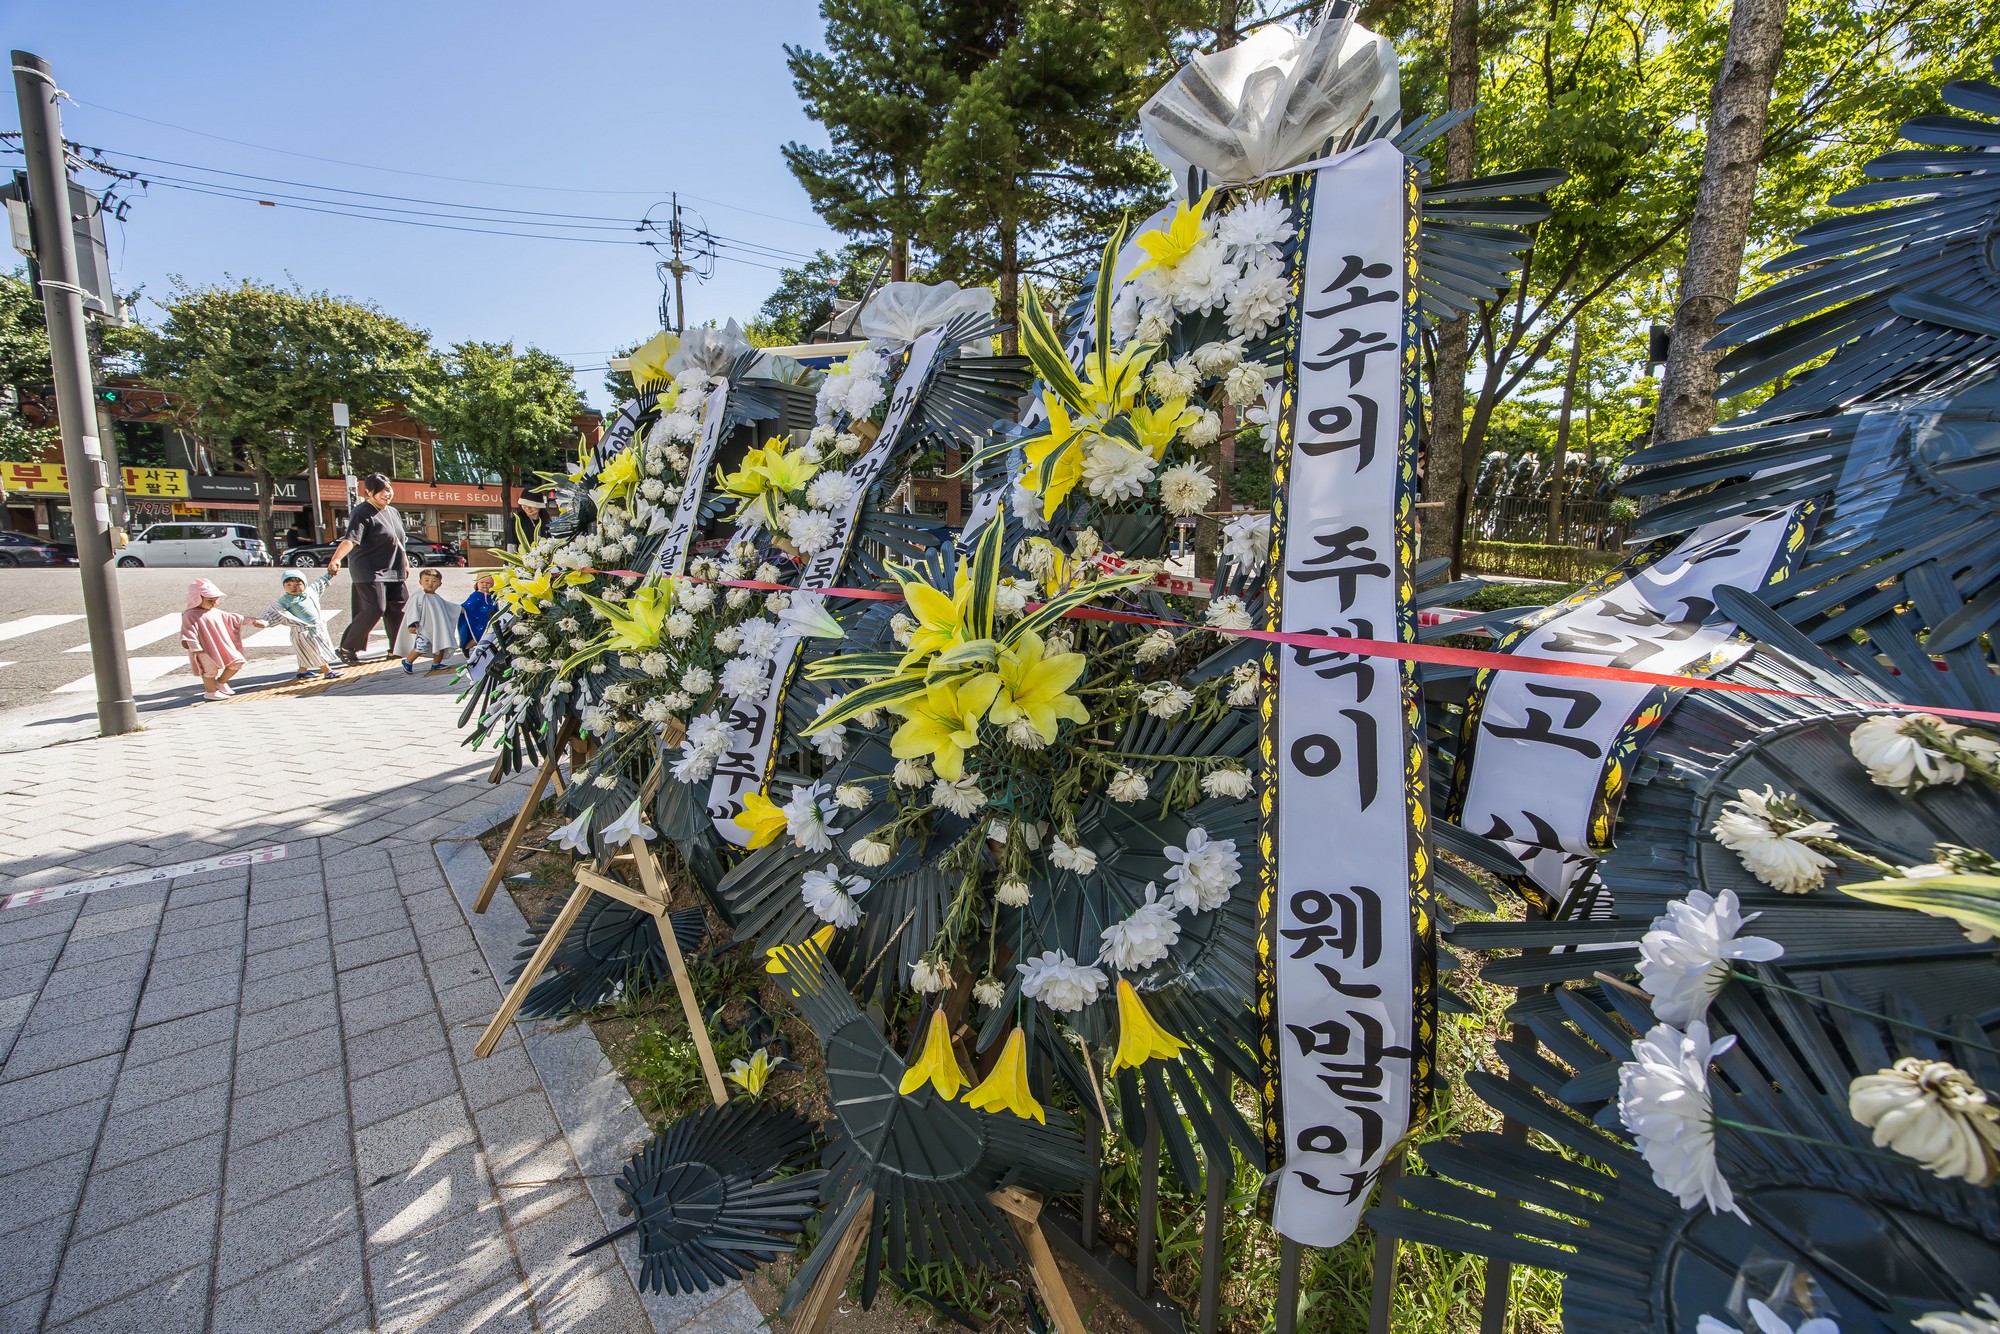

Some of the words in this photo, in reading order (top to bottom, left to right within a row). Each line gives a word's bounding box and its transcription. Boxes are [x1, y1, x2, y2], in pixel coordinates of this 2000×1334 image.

[1298, 255, 1400, 474] 소수의
[145, 470, 179, 482] 사구
[682, 421, 717, 512] 120년
[849, 386, 914, 490] 마지막
[145, 482, 181, 495] 팔구
[414, 489, 460, 501] REPÈRE
[1286, 525, 1391, 813] 주택이
[1280, 886, 1411, 1207] 웬말인
